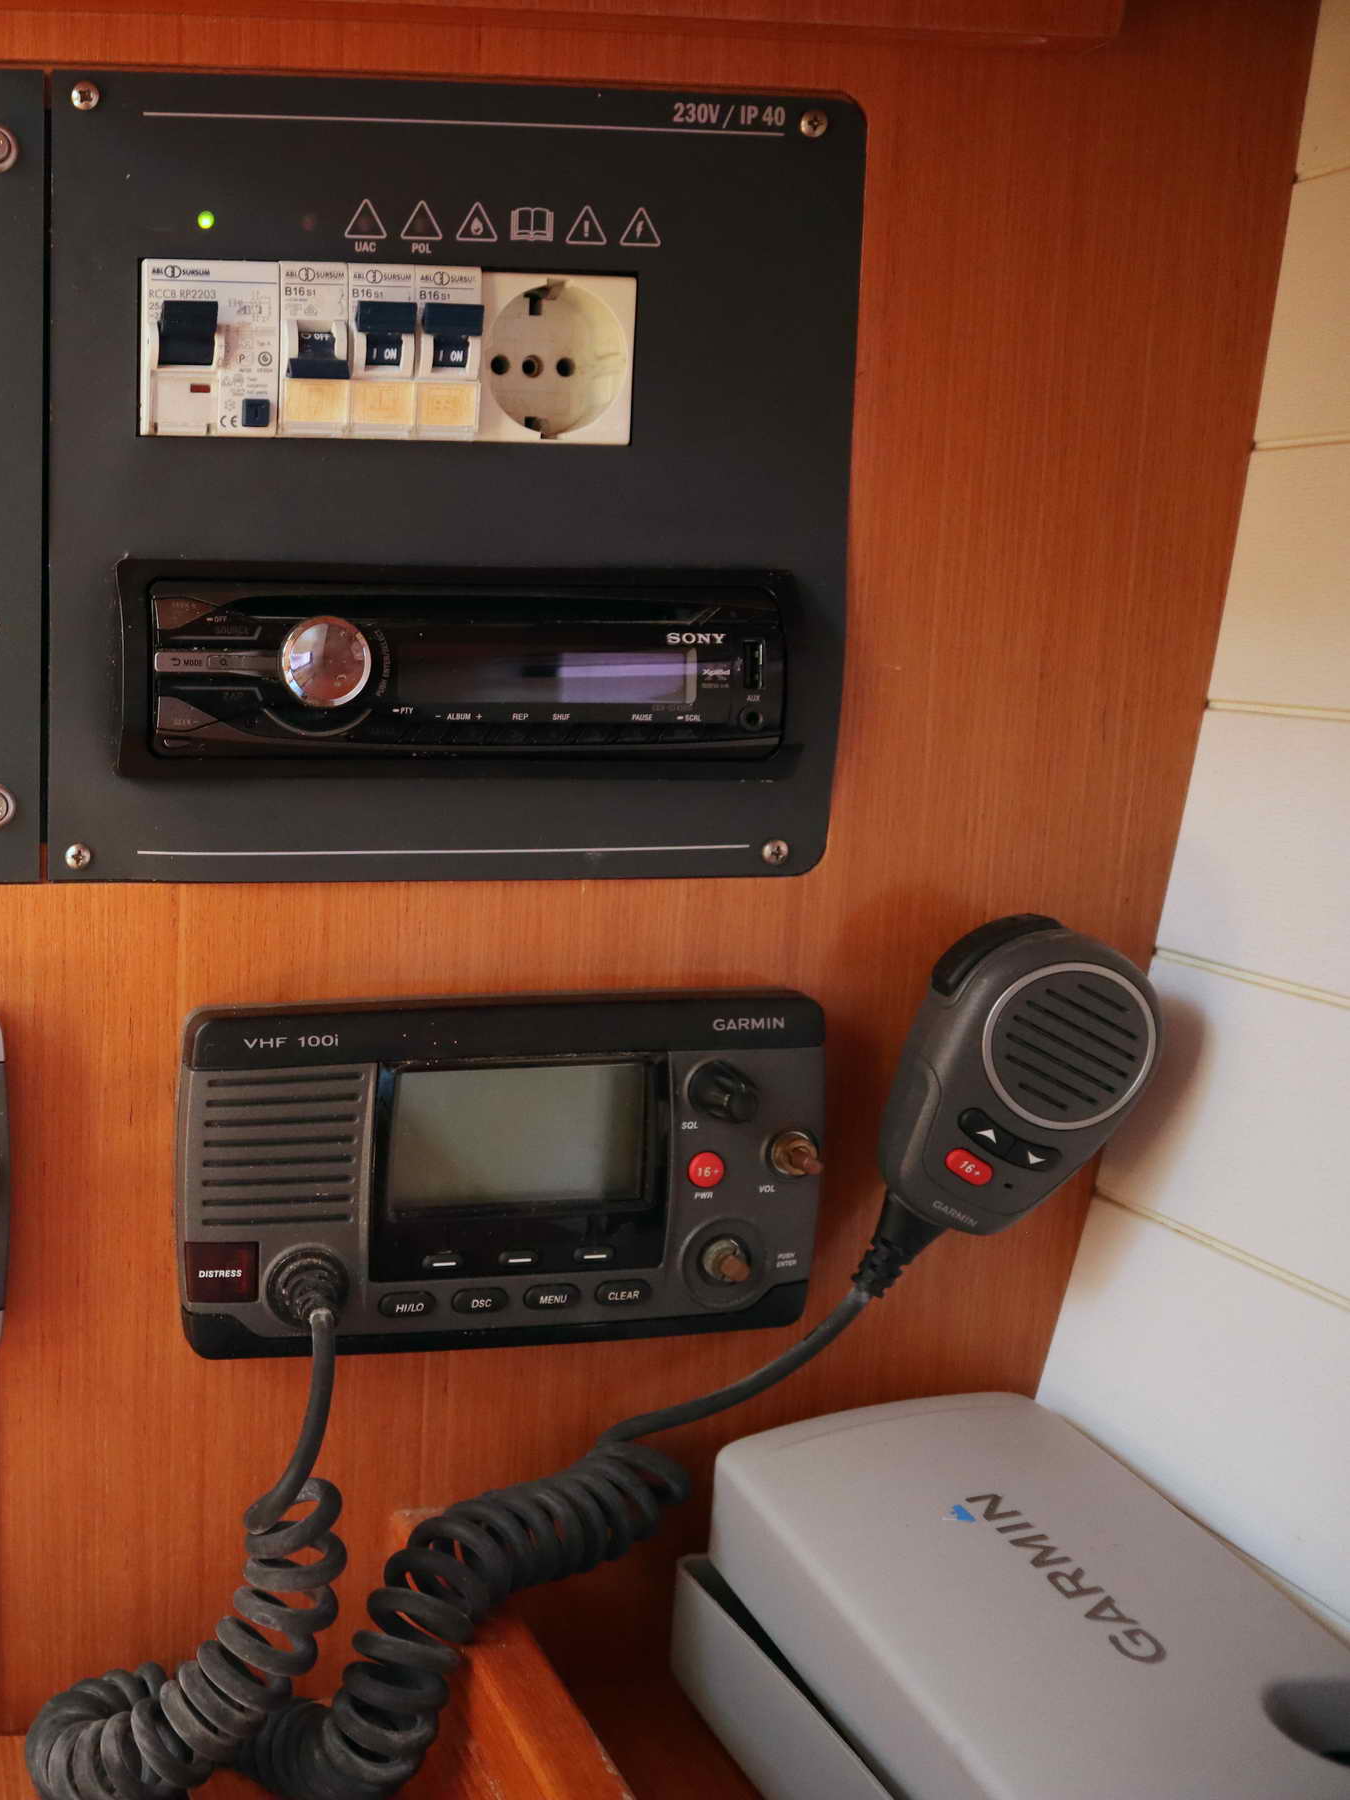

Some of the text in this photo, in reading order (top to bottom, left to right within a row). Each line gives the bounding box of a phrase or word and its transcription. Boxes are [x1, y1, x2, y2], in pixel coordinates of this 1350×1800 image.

[673, 102, 720, 124] 230V
[740, 105, 759, 125] IP
[762, 106, 786, 126] 40
[354, 242, 376, 253] UAC
[411, 243, 432, 254] POL
[285, 287, 306, 296] B16
[352, 288, 373, 298] B16
[419, 290, 440, 299] B16
[384, 348, 398, 360] ON
[450, 350, 464, 362] ON
[666, 631, 727, 645] SONY
[447, 713, 471, 721] ALBUM
[552, 713, 571, 721] SHUF
[631, 713, 653, 721] PAUSE
[712, 1017, 785, 1031] GARMIN
[243, 1033, 339, 1049] VHF 100i
[681, 1121, 699, 1130] SQL
[758, 1184, 776, 1193] VOL
[694, 1191, 714, 1200] PWR
[932, 1199, 978, 1228] GARMIN
[198, 1269, 242, 1278] DISTRESS
[539, 1294, 568, 1305] MENU
[608, 1290, 640, 1301] CLEAR
[395, 1302, 425, 1313] HI/LO
[471, 1298, 492, 1309] DSC
[965, 1493, 1167, 1664] GARMIN
